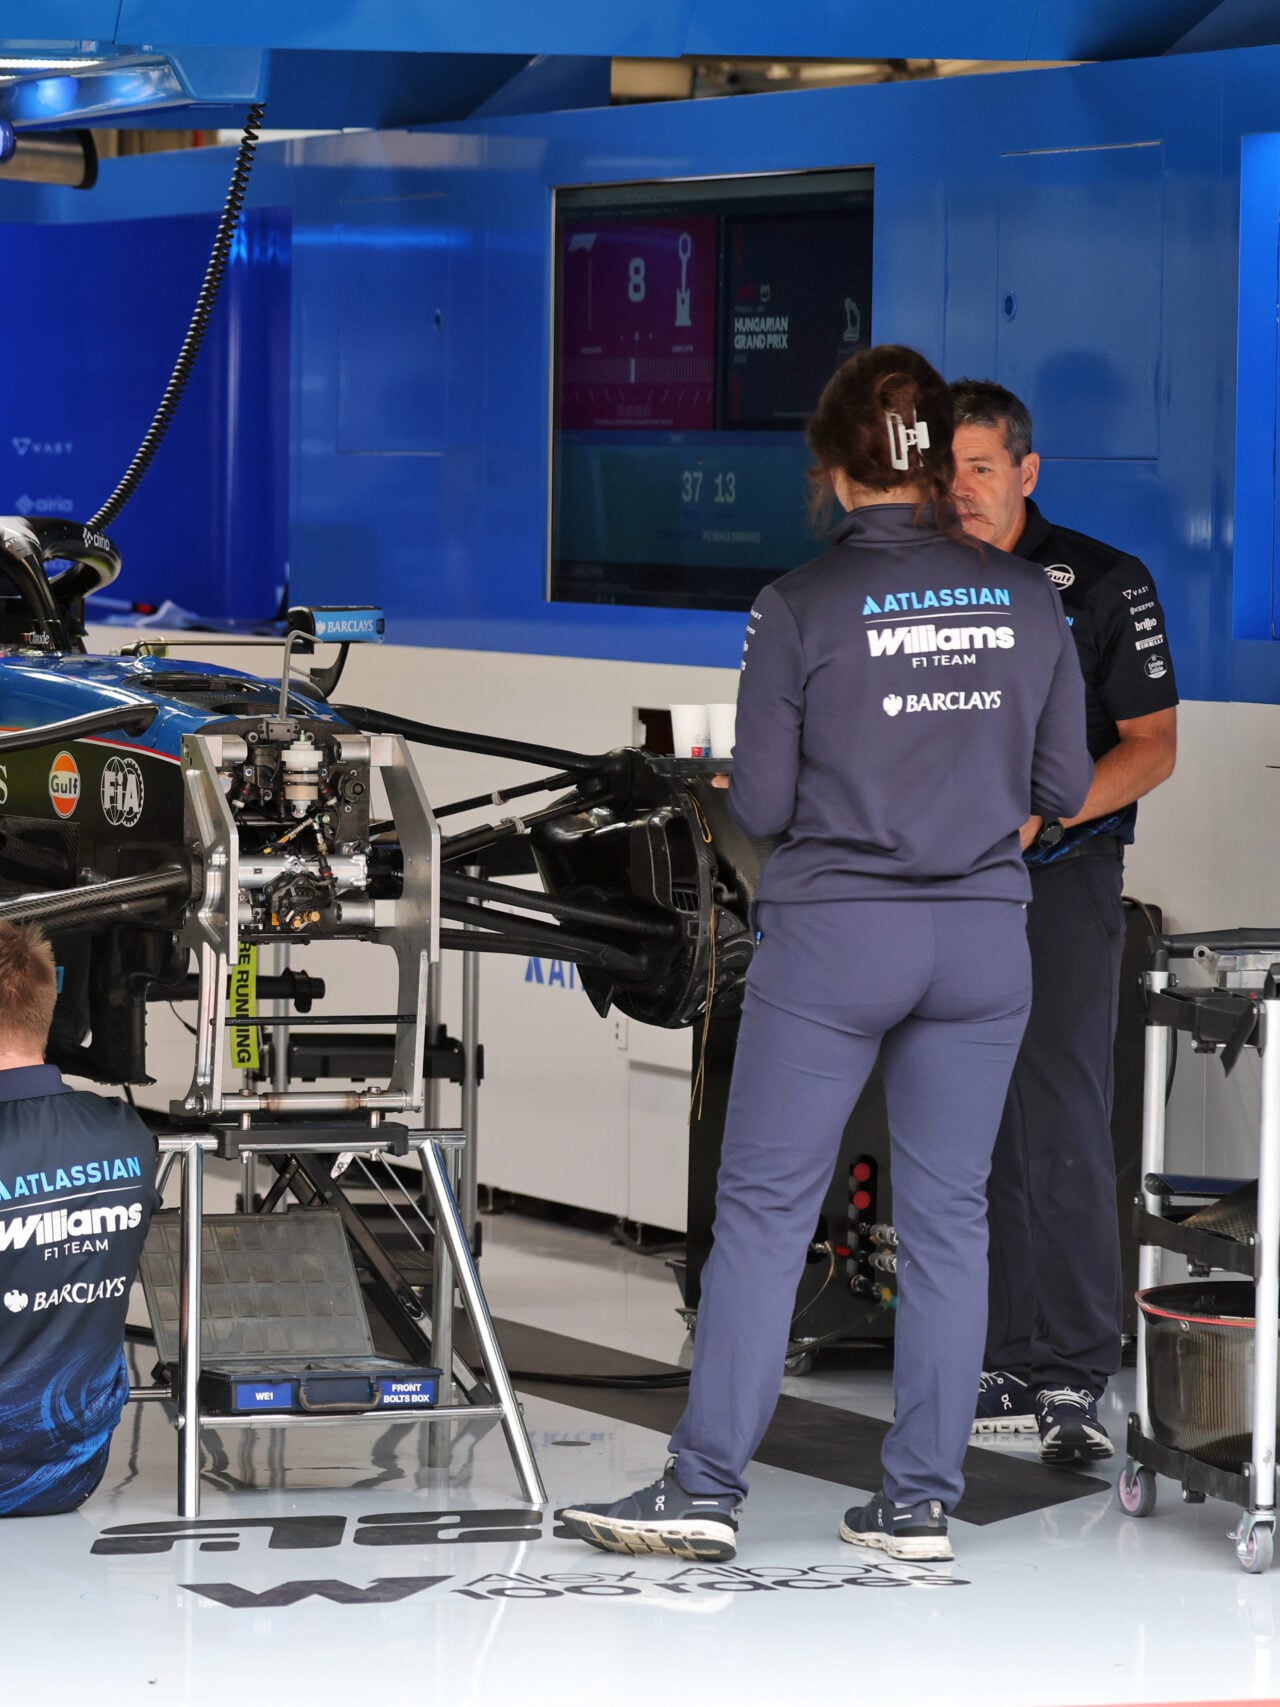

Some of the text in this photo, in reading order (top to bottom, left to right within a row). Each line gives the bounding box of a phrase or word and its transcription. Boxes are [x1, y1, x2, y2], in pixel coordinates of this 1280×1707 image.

[628, 257, 646, 302] 8
[734, 317, 789, 334] HUNGARIAN
[734, 333, 789, 350] GRAND PRIX
[31, 442, 73, 453] VAST
[682, 471, 704, 503] 37
[714, 472, 736, 503] 13
[35, 494, 74, 513] airia
[93, 531, 111, 552] airia
[883, 587, 1011, 613] ATLASSIAN
[327, 619, 374, 633] BARCLAYS
[28, 631, 50, 645] Claude
[866, 623, 1016, 658] Williams
[912, 653, 977, 669] F1 TEAM
[905, 690, 1002, 713] BARCLAYS
[50, 774, 79, 795] Gulf
[14, 1156, 142, 1199] ATLASSIAN
[43, 1239, 110, 1262] F1 TEAM
[32, 1276, 127, 1312] BARCLAYS
[255, 1392, 274, 1401] WE1
[383, 1394, 430, 1403] BOLTS BOX
[391, 1383, 422, 1393] FRONT
[464, 1563, 937, 1588] Alex Albon
[450, 1574, 973, 1601] 100 races
